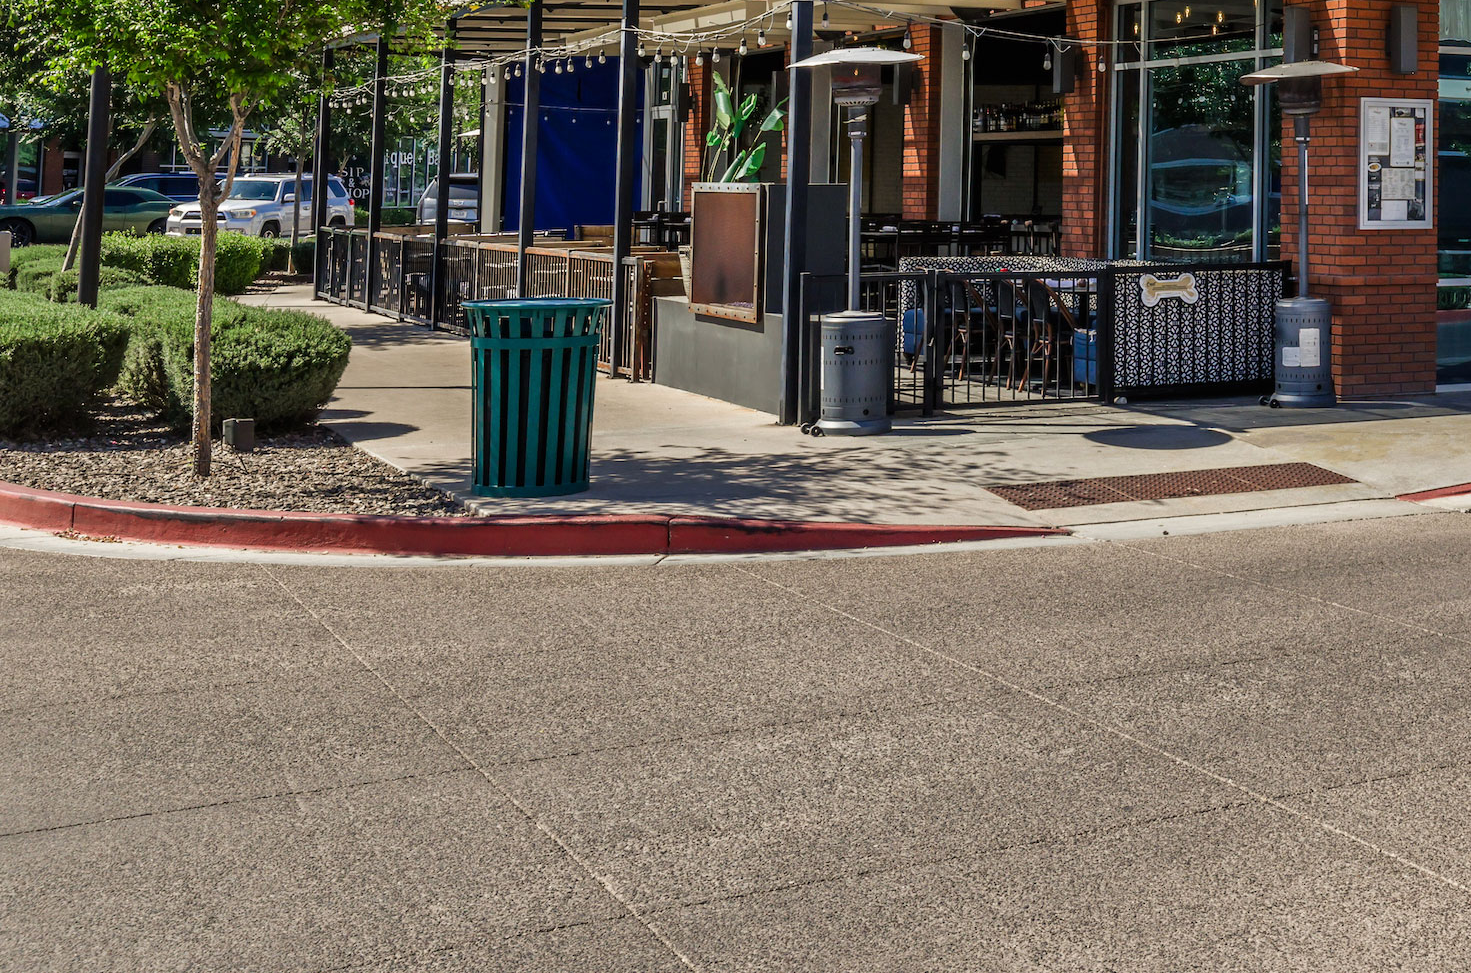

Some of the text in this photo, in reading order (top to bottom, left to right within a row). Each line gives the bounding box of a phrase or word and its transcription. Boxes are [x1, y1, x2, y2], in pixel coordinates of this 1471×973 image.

[384, 149, 413, 168] ique
[428, 149, 440, 165] Ba
[338, 167, 364, 177] SIP
